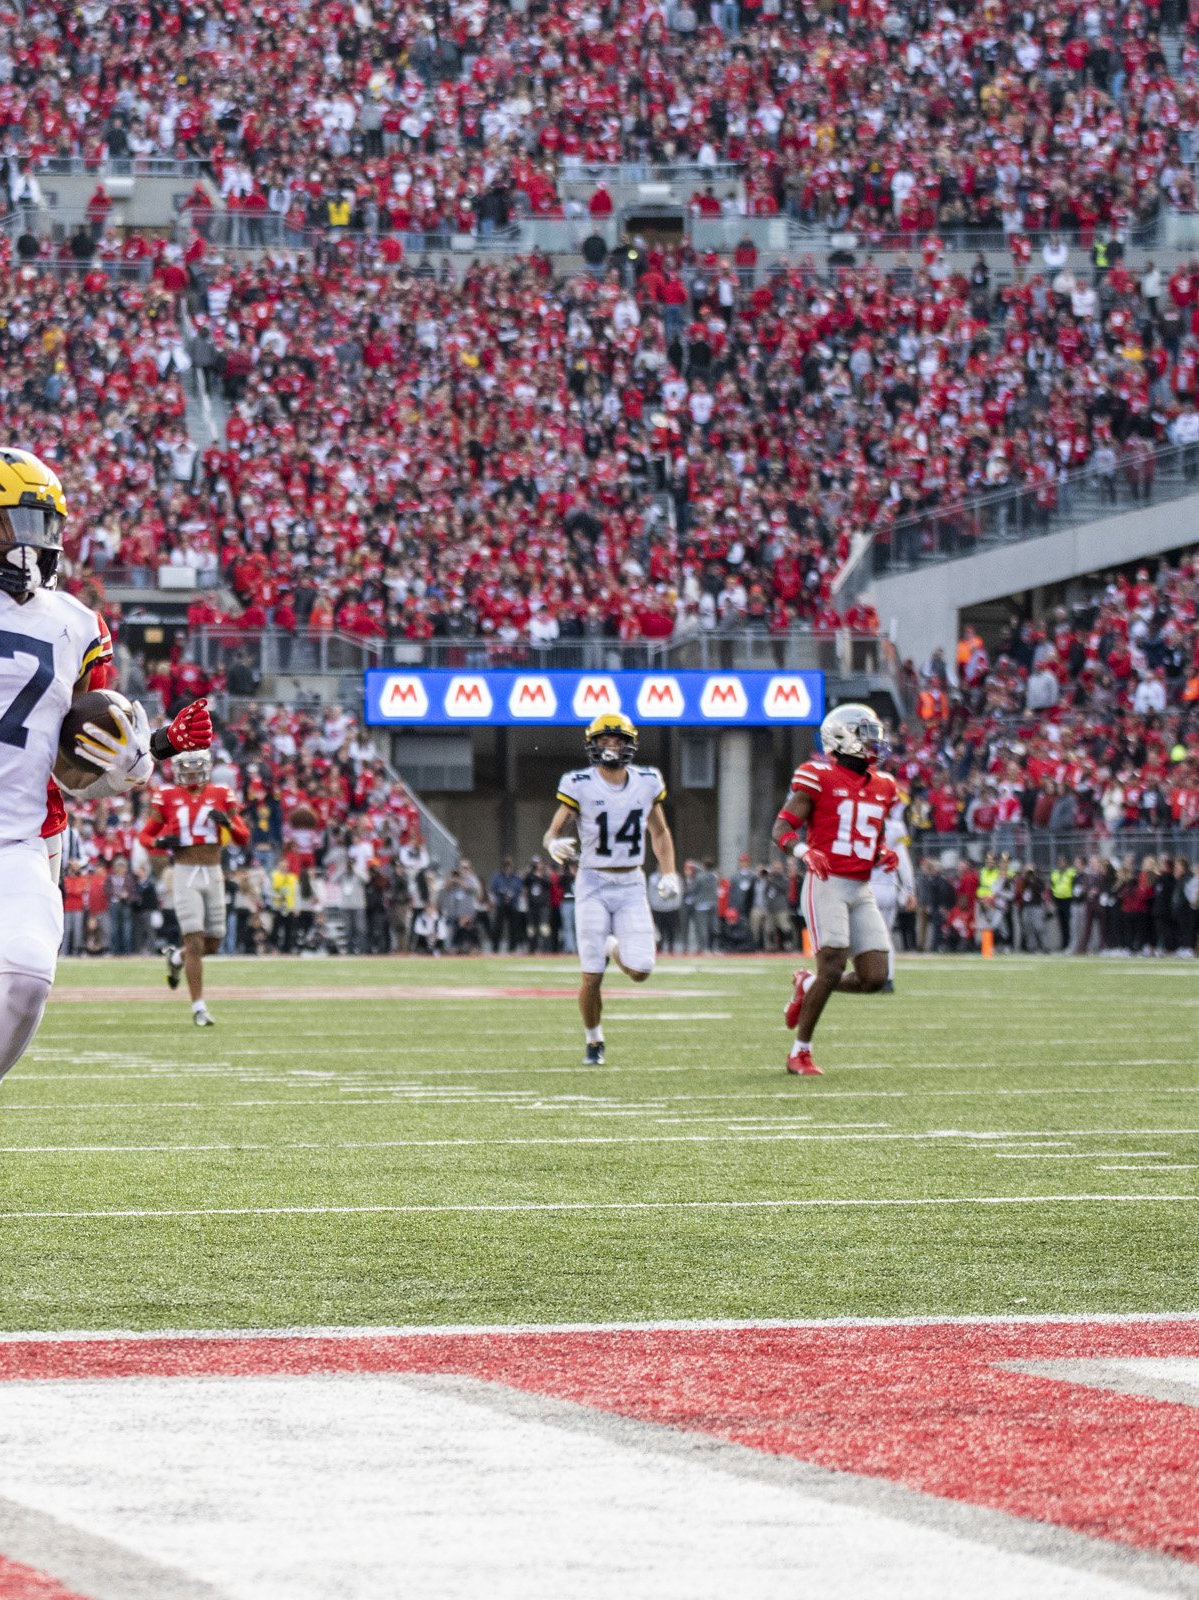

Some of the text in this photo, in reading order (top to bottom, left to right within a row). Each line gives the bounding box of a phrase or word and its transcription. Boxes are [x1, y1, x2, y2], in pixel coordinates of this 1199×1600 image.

[176, 805, 218, 847] 14
[595, 809, 644, 858] 14
[831, 799, 884, 861] 15
